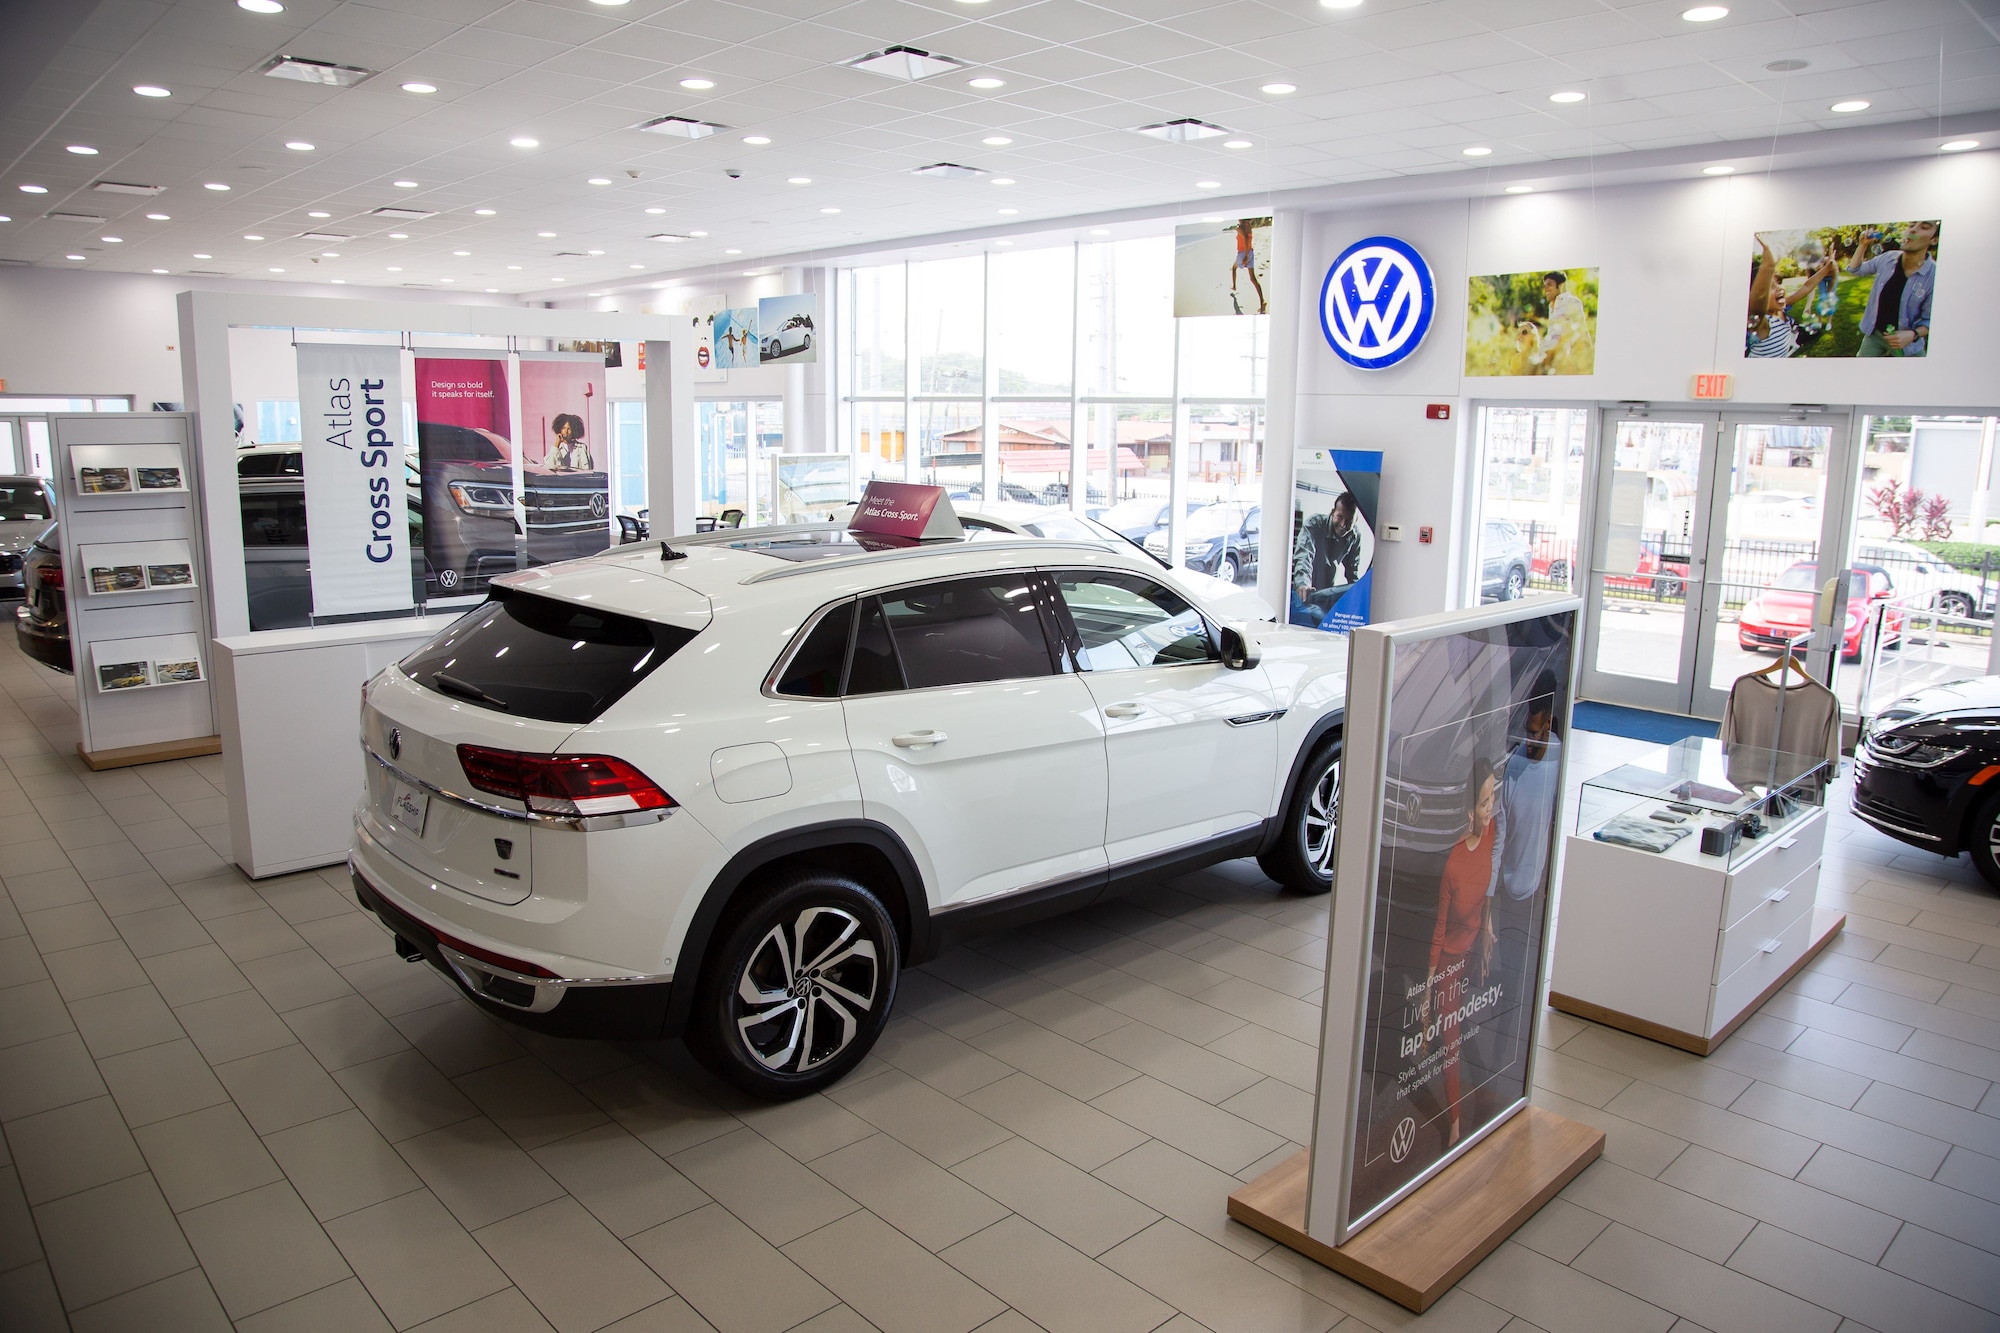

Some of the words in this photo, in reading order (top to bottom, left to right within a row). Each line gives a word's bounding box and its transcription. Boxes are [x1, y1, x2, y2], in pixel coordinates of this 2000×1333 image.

[1325, 246, 1422, 359] VW
[431, 380, 456, 390] Design
[467, 381, 483, 389] bold
[431, 390, 437, 398] it
[438, 390, 463, 399] speaks
[464, 390, 474, 398] for
[475, 390, 495, 398] itself.
[1695, 374, 1727, 397] EXIT
[323, 377, 353, 450] Atlas
[360, 378, 394, 468] Sport
[366, 476, 393, 563] Cross
[864, 507, 881, 516] Atlas
[881, 509, 898, 518] Cross
[899, 510, 919, 521] Sport.
[868, 495, 885, 505] Meet
[885, 497, 895, 507] the
[397, 796, 419, 816] FLAGSHIP
[1406, 982, 1426, 999] Atlas
[1427, 971, 1446, 988] Cross
[1446, 959, 1465, 977] Sport
[1400, 1033, 1423, 1058] lap
[1426, 1018, 1443, 1041] of
[1443, 983, 1504, 1031] modesty.
[1403, 1002, 1430, 1029] Live
[1433, 990, 1445, 1010] in
[1448, 977, 1469, 1002] the
[1396, 1085, 1411, 1100] that
[1412, 1073, 1432, 1091] speak
[1432, 1063, 1443, 1076] for
[1443, 1051, 1461, 1069] itself.
[1397, 1066, 1417, 1084] Style,
[1418, 1044, 1450, 1071] versatility
[1449, 1035, 1463, 1050] and
[1463, 1025, 1480, 1042] value
[1390, 1117, 1416, 1163] VW
